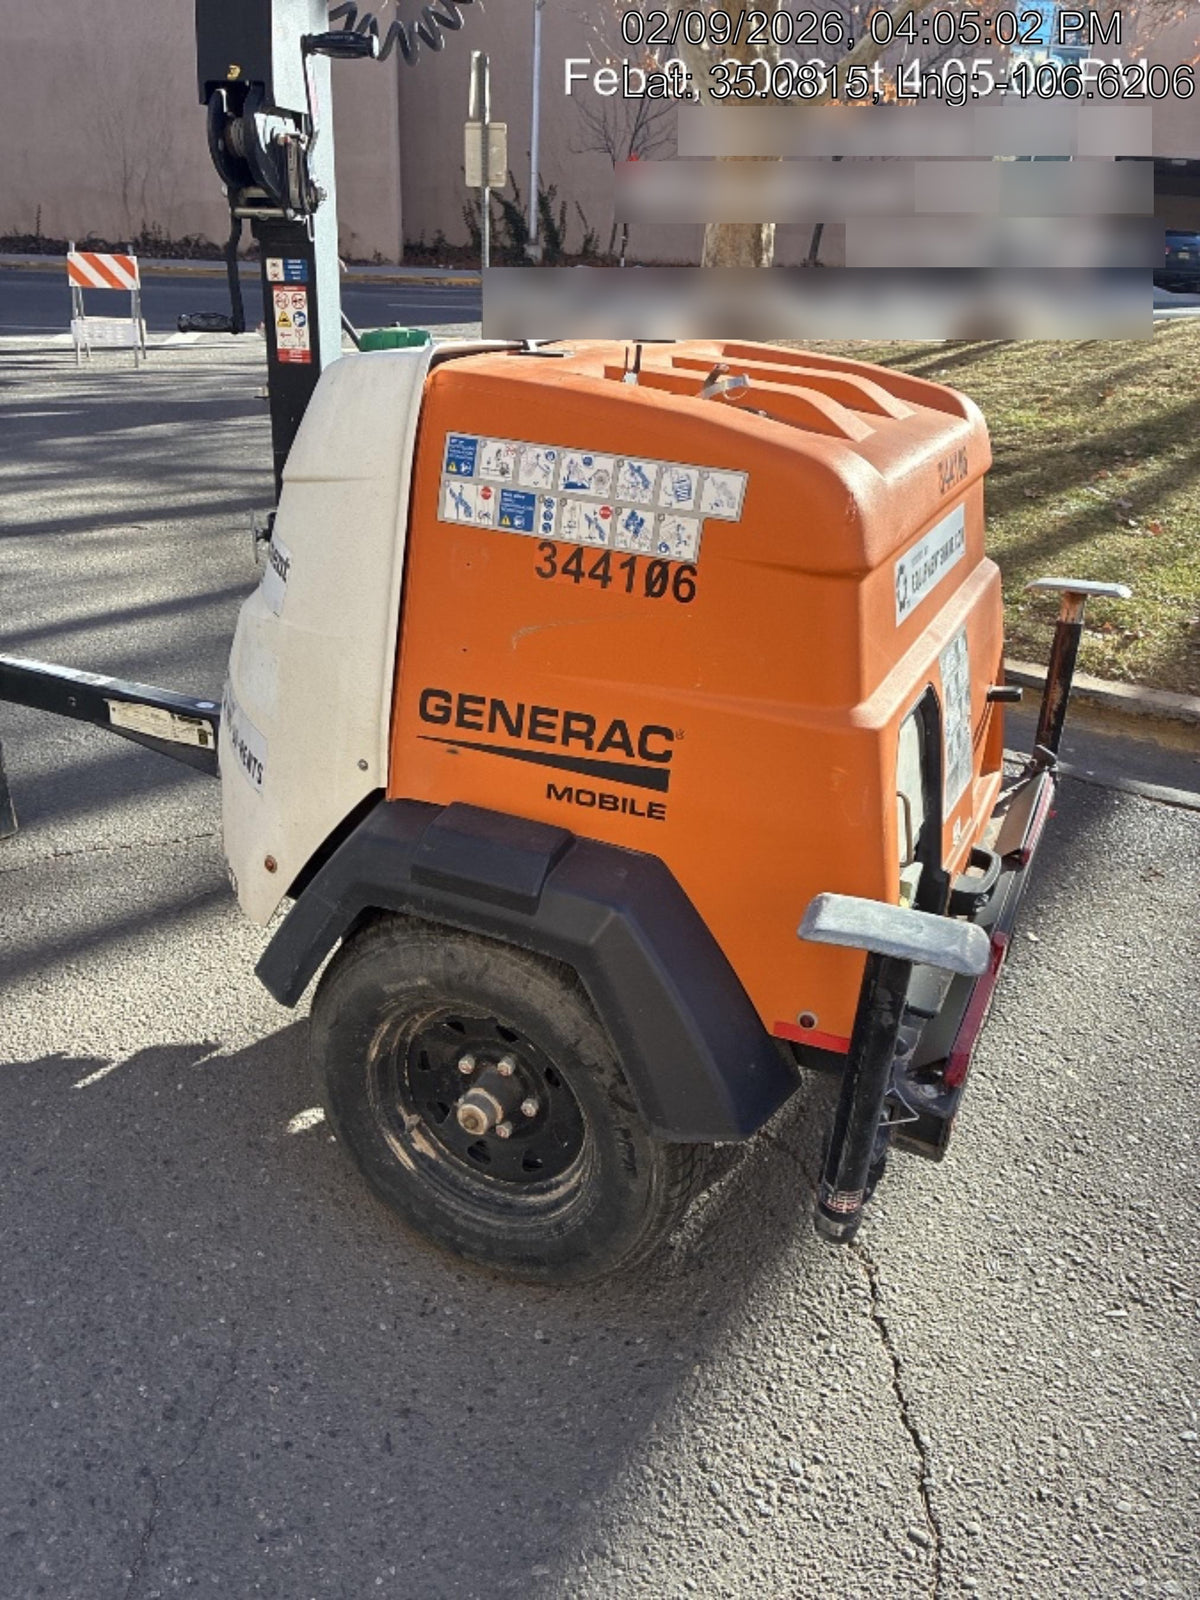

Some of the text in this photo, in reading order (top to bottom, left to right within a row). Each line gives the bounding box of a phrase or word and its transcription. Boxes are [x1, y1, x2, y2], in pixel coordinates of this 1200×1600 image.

[535, 540, 698, 603] 344106
[419, 687, 675, 763] GENERAC
[546, 783, 668, 821] MOBILE
